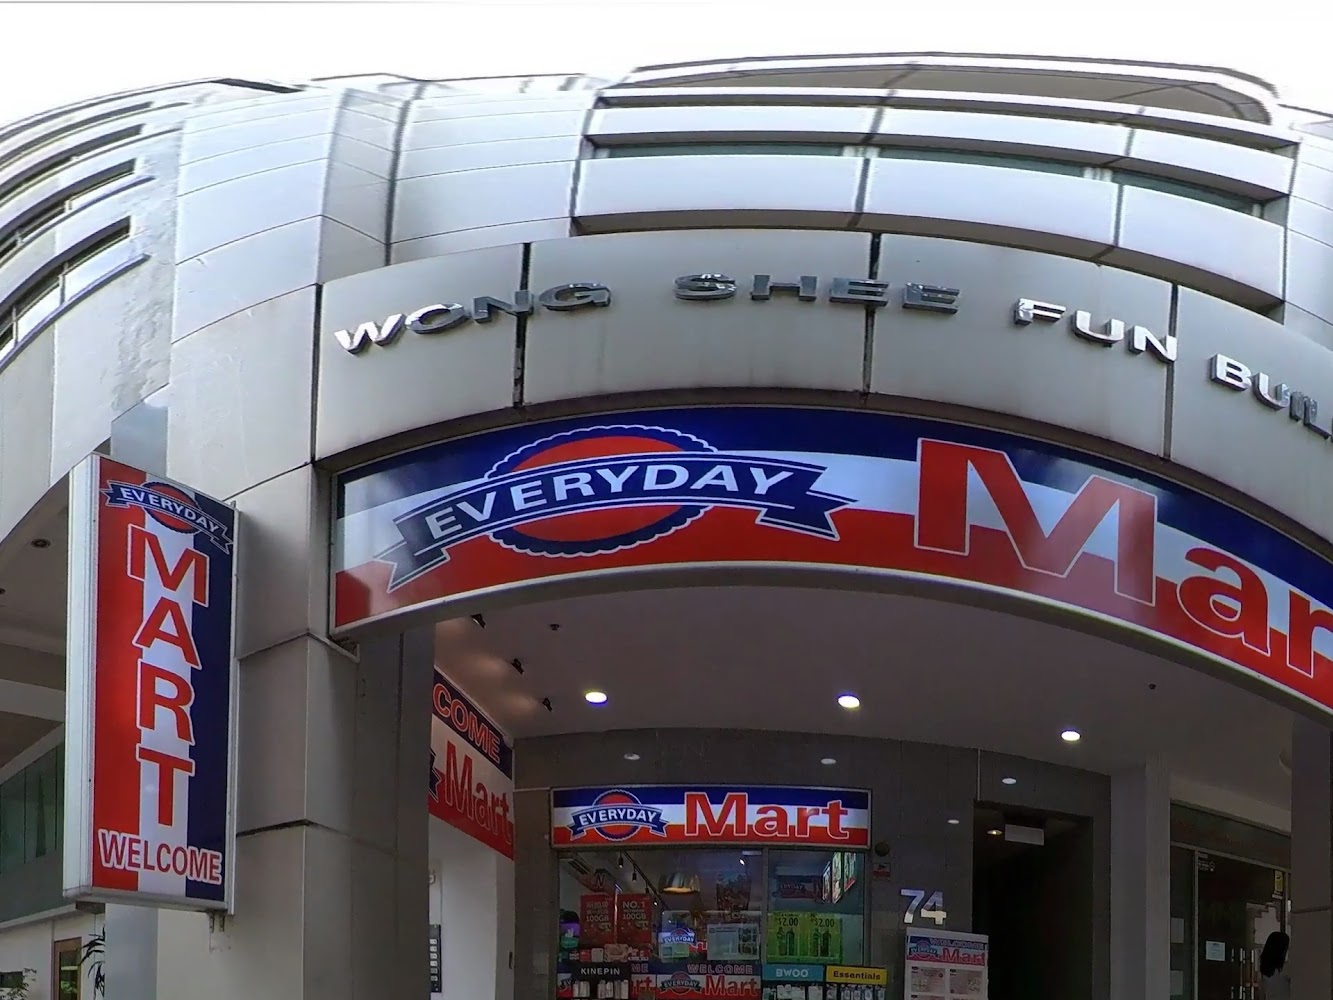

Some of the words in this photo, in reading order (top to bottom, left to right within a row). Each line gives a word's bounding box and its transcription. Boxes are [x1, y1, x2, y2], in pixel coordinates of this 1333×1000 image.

[334, 282, 611, 354] WONG
[674, 273, 960, 314] SHEE
[1014, 297, 1177, 363] FUN
[120, 487, 219, 533] EVERYDAY
[425, 464, 794, 541] EVERYDAY
[127, 523, 209, 827] MART
[444, 740, 512, 845] Mart
[579, 808, 657, 824] EVERYDAY
[684, 791, 850, 839] Mart
[98, 829, 223, 884] WELCOME
[901, 888, 947, 925] 74
[778, 917, 799, 927] $2.00
[814, 918, 835, 928] $2.00
[580, 967, 620, 976] KINEPIN
[686, 964, 754, 974] WELCOME
[942, 947, 986, 966] Mart
[664, 979, 699, 987] EVERYDAY
[704, 973, 758, 997] Mart
[776, 968, 809, 978] BWOO
[832, 970, 881, 980] Essentials
